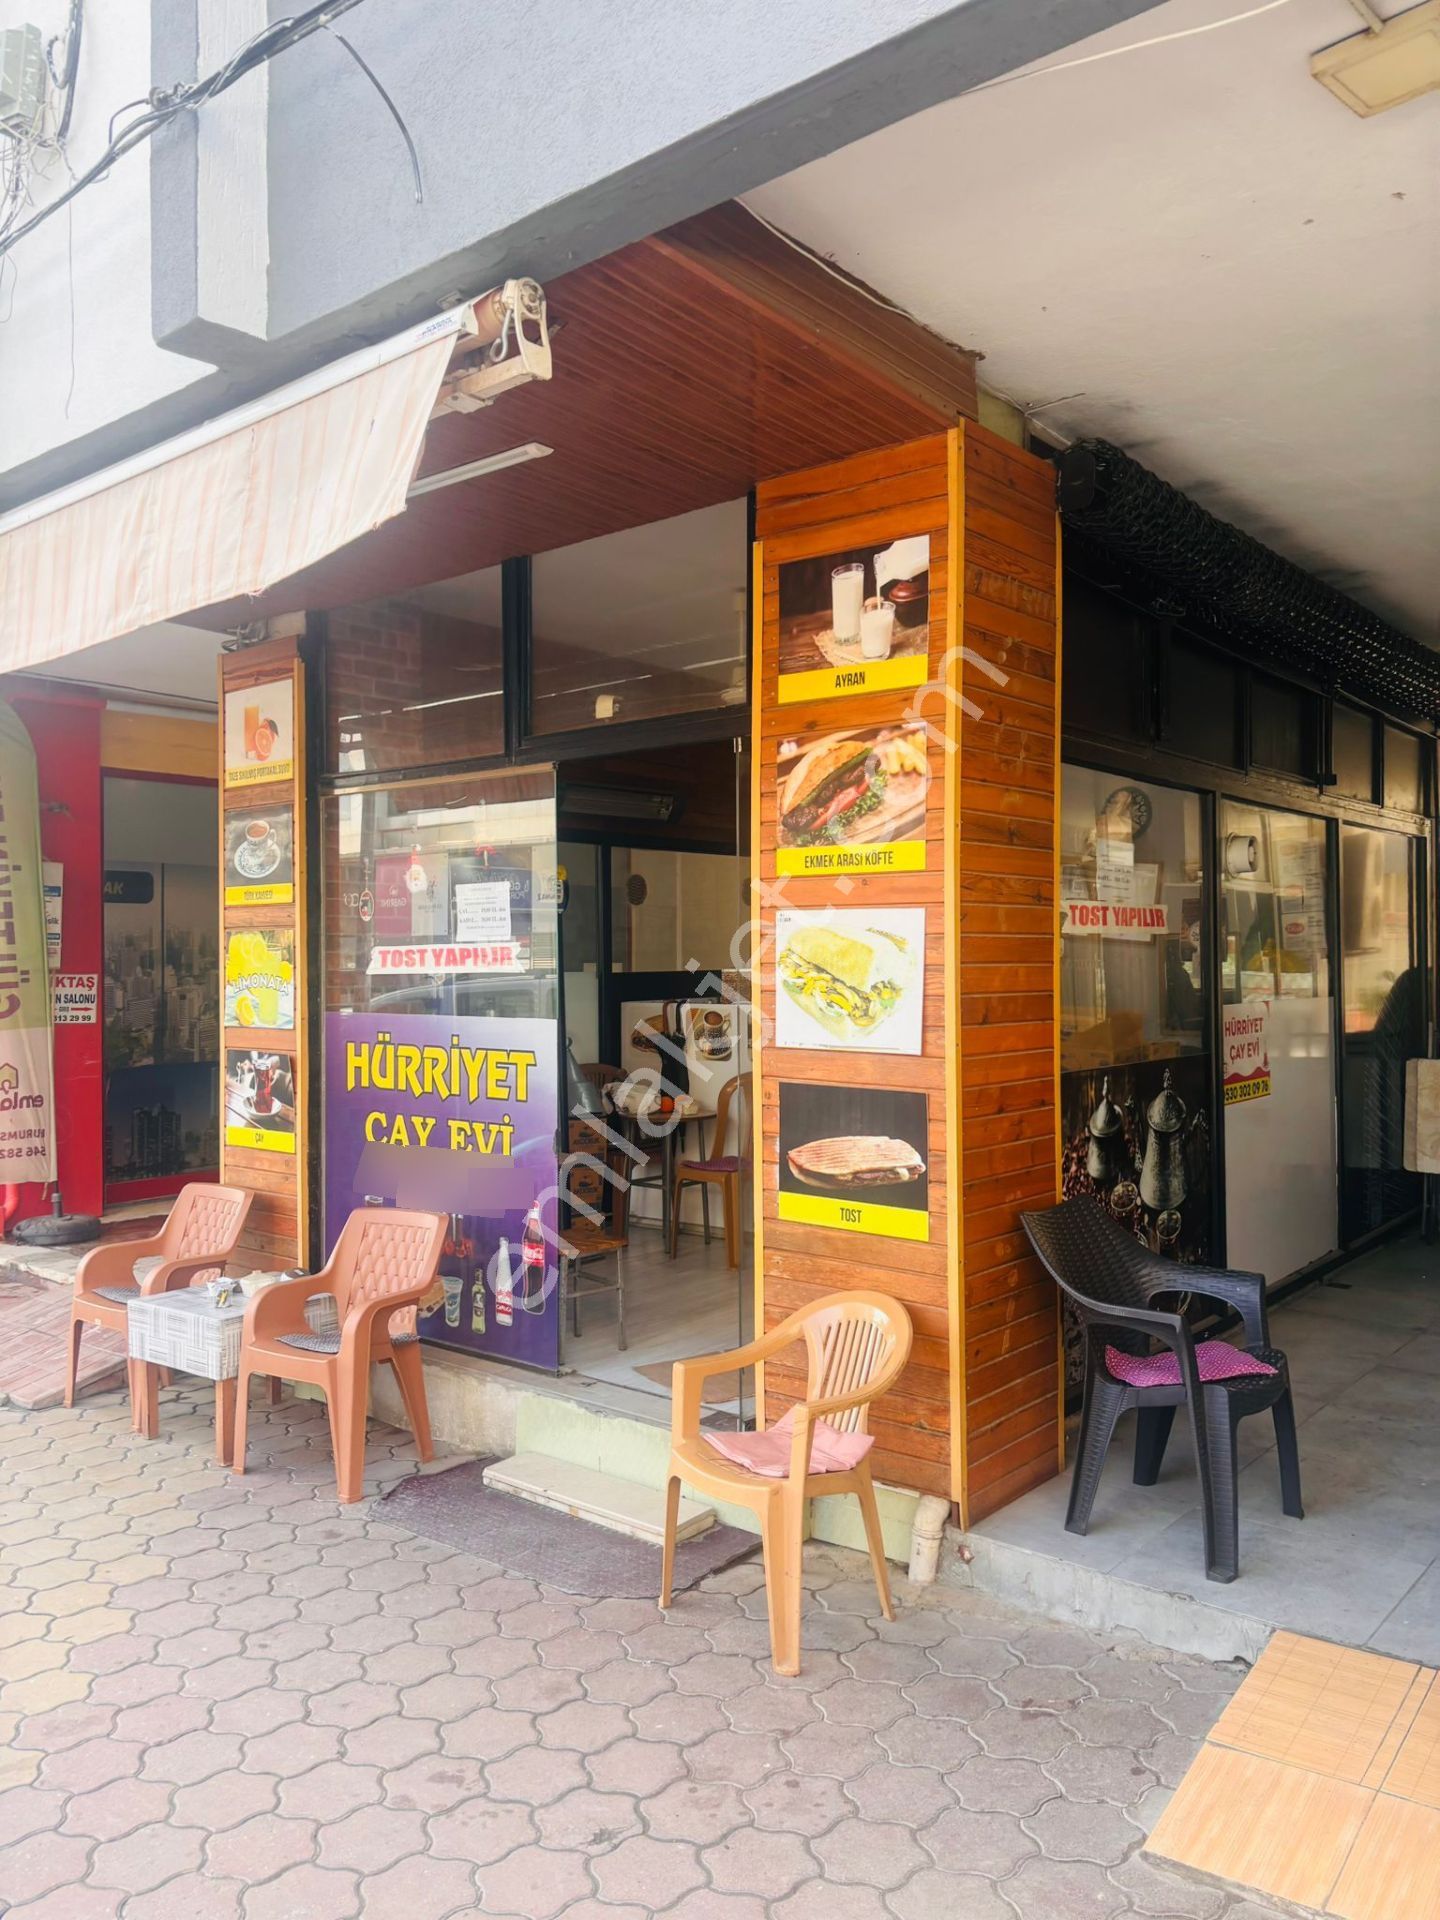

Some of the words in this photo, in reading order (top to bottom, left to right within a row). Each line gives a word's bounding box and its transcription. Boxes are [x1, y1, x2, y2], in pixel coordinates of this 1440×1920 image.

[835, 671, 866, 689] AYRAN
[804, 854, 835, 869] EKMEK
[865, 849, 894, 866] KÖFTE
[1069, 904, 1110, 926] TOST
[1112, 905, 1165, 928] YAPILIR
[378, 948, 428, 969] TOST
[431, 946, 513, 967] YAPILIR
[55, 976, 96, 991] KTAŞ
[64, 994, 96, 1004] SALONU
[69, 1014, 80, 1022] 29
[81, 1014, 92, 1022] 99
[1224, 1015, 1264, 1037] HÜRRİYET
[1229, 1043, 1246, 1065] ÇAY
[1247, 1037, 1260, 1058] EVİ
[345, 1031, 538, 1105] HÜRRİYET
[1239, 1083, 1251, 1098] 302
[447, 1112, 515, 1157] EVİ
[839, 1207, 862, 1223] TOST
